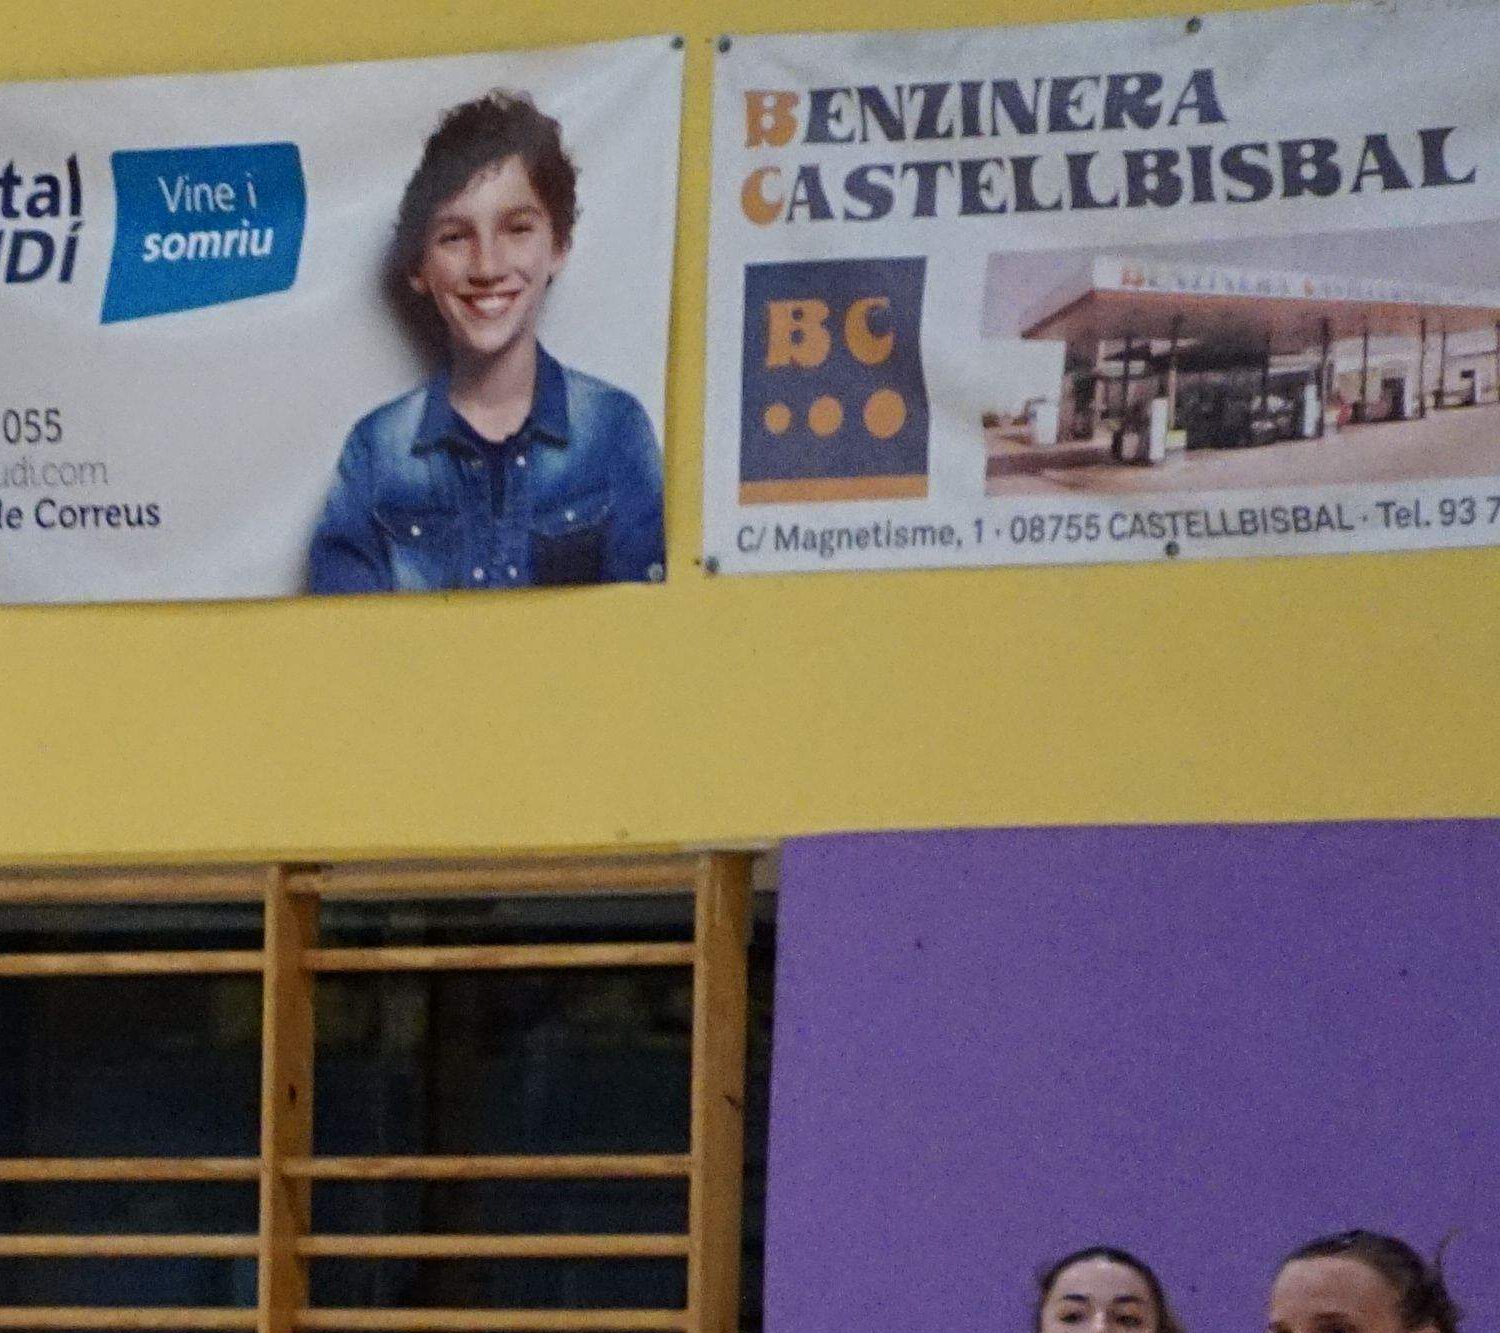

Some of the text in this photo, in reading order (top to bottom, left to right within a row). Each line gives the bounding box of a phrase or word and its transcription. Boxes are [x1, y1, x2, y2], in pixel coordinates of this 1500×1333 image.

[743, 68, 1228, 147] BENZINERA
[159, 172, 258, 214] Vine i
[740, 126, 1477, 226] CASTELLBISBAL
[142, 221, 273, 264] somriu
[3, 408, 62, 442] 055
[34, 495, 159, 530] Correus
[738, 525, 770, 553] C/
[776, 521, 963, 557] Magnetisme,
[974, 519, 984, 545] 1
[1010, 514, 1100, 544] 08755
[1109, 505, 1354, 540] CASTELLBISBAL
[1375, 498, 1431, 529] Tel.
[1439, 497, 1476, 526] 93
